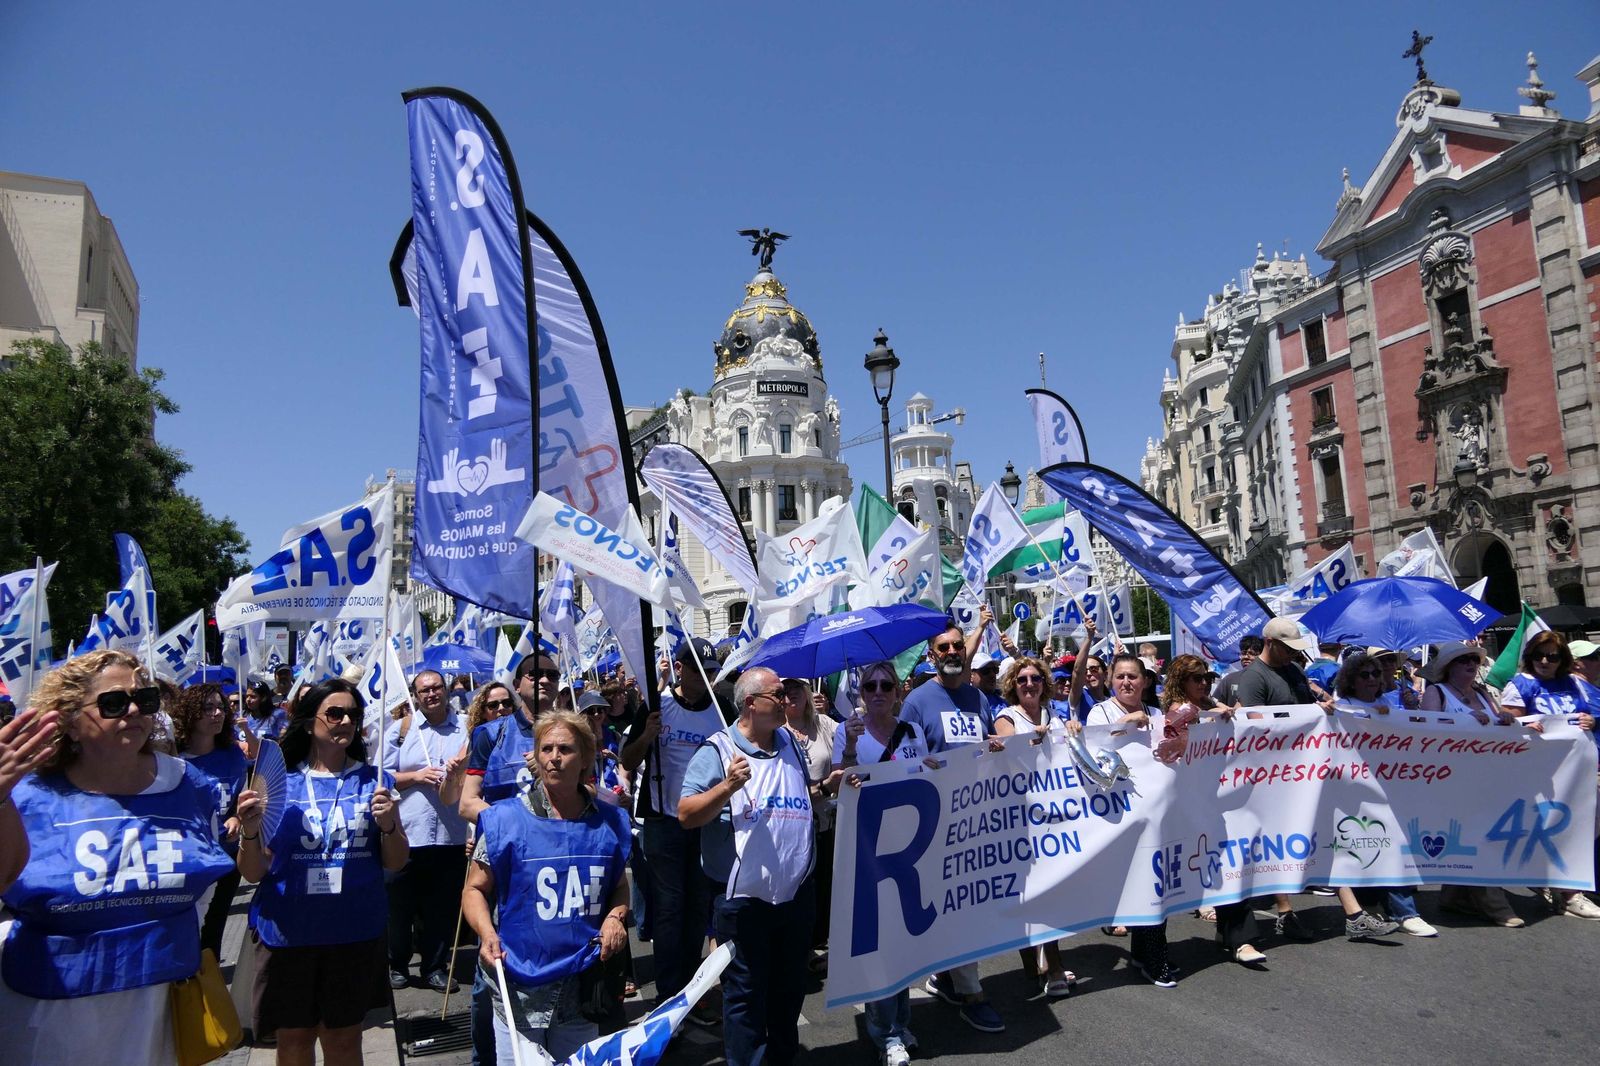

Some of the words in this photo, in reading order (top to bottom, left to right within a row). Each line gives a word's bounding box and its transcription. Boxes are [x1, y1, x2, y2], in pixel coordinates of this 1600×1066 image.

[760, 383, 807, 394] METROPOLIS
[1185, 728, 1289, 766] JUBILACIÓN
[1291, 731, 1414, 752] ANTICIPADA
[1420, 737, 1437, 753] Y
[1438, 738, 1532, 755] PARCIAL
[1233, 757, 1345, 788] PROFESIÓN
[1350, 761, 1370, 780] DE
[1375, 761, 1452, 784] RIESGO
[945, 788, 1132, 847] ECLASIFICACIÓN
[1485, 798, 1573, 876] 4R
[851, 778, 941, 958] R
[942, 828, 1082, 881] ETRIBUCIÓN
[1218, 831, 1318, 868] TECNOS
[94, 901, 105, 911] DE
[144, 896, 154, 905] DE
[942, 873, 1021, 915] APIDEZ
